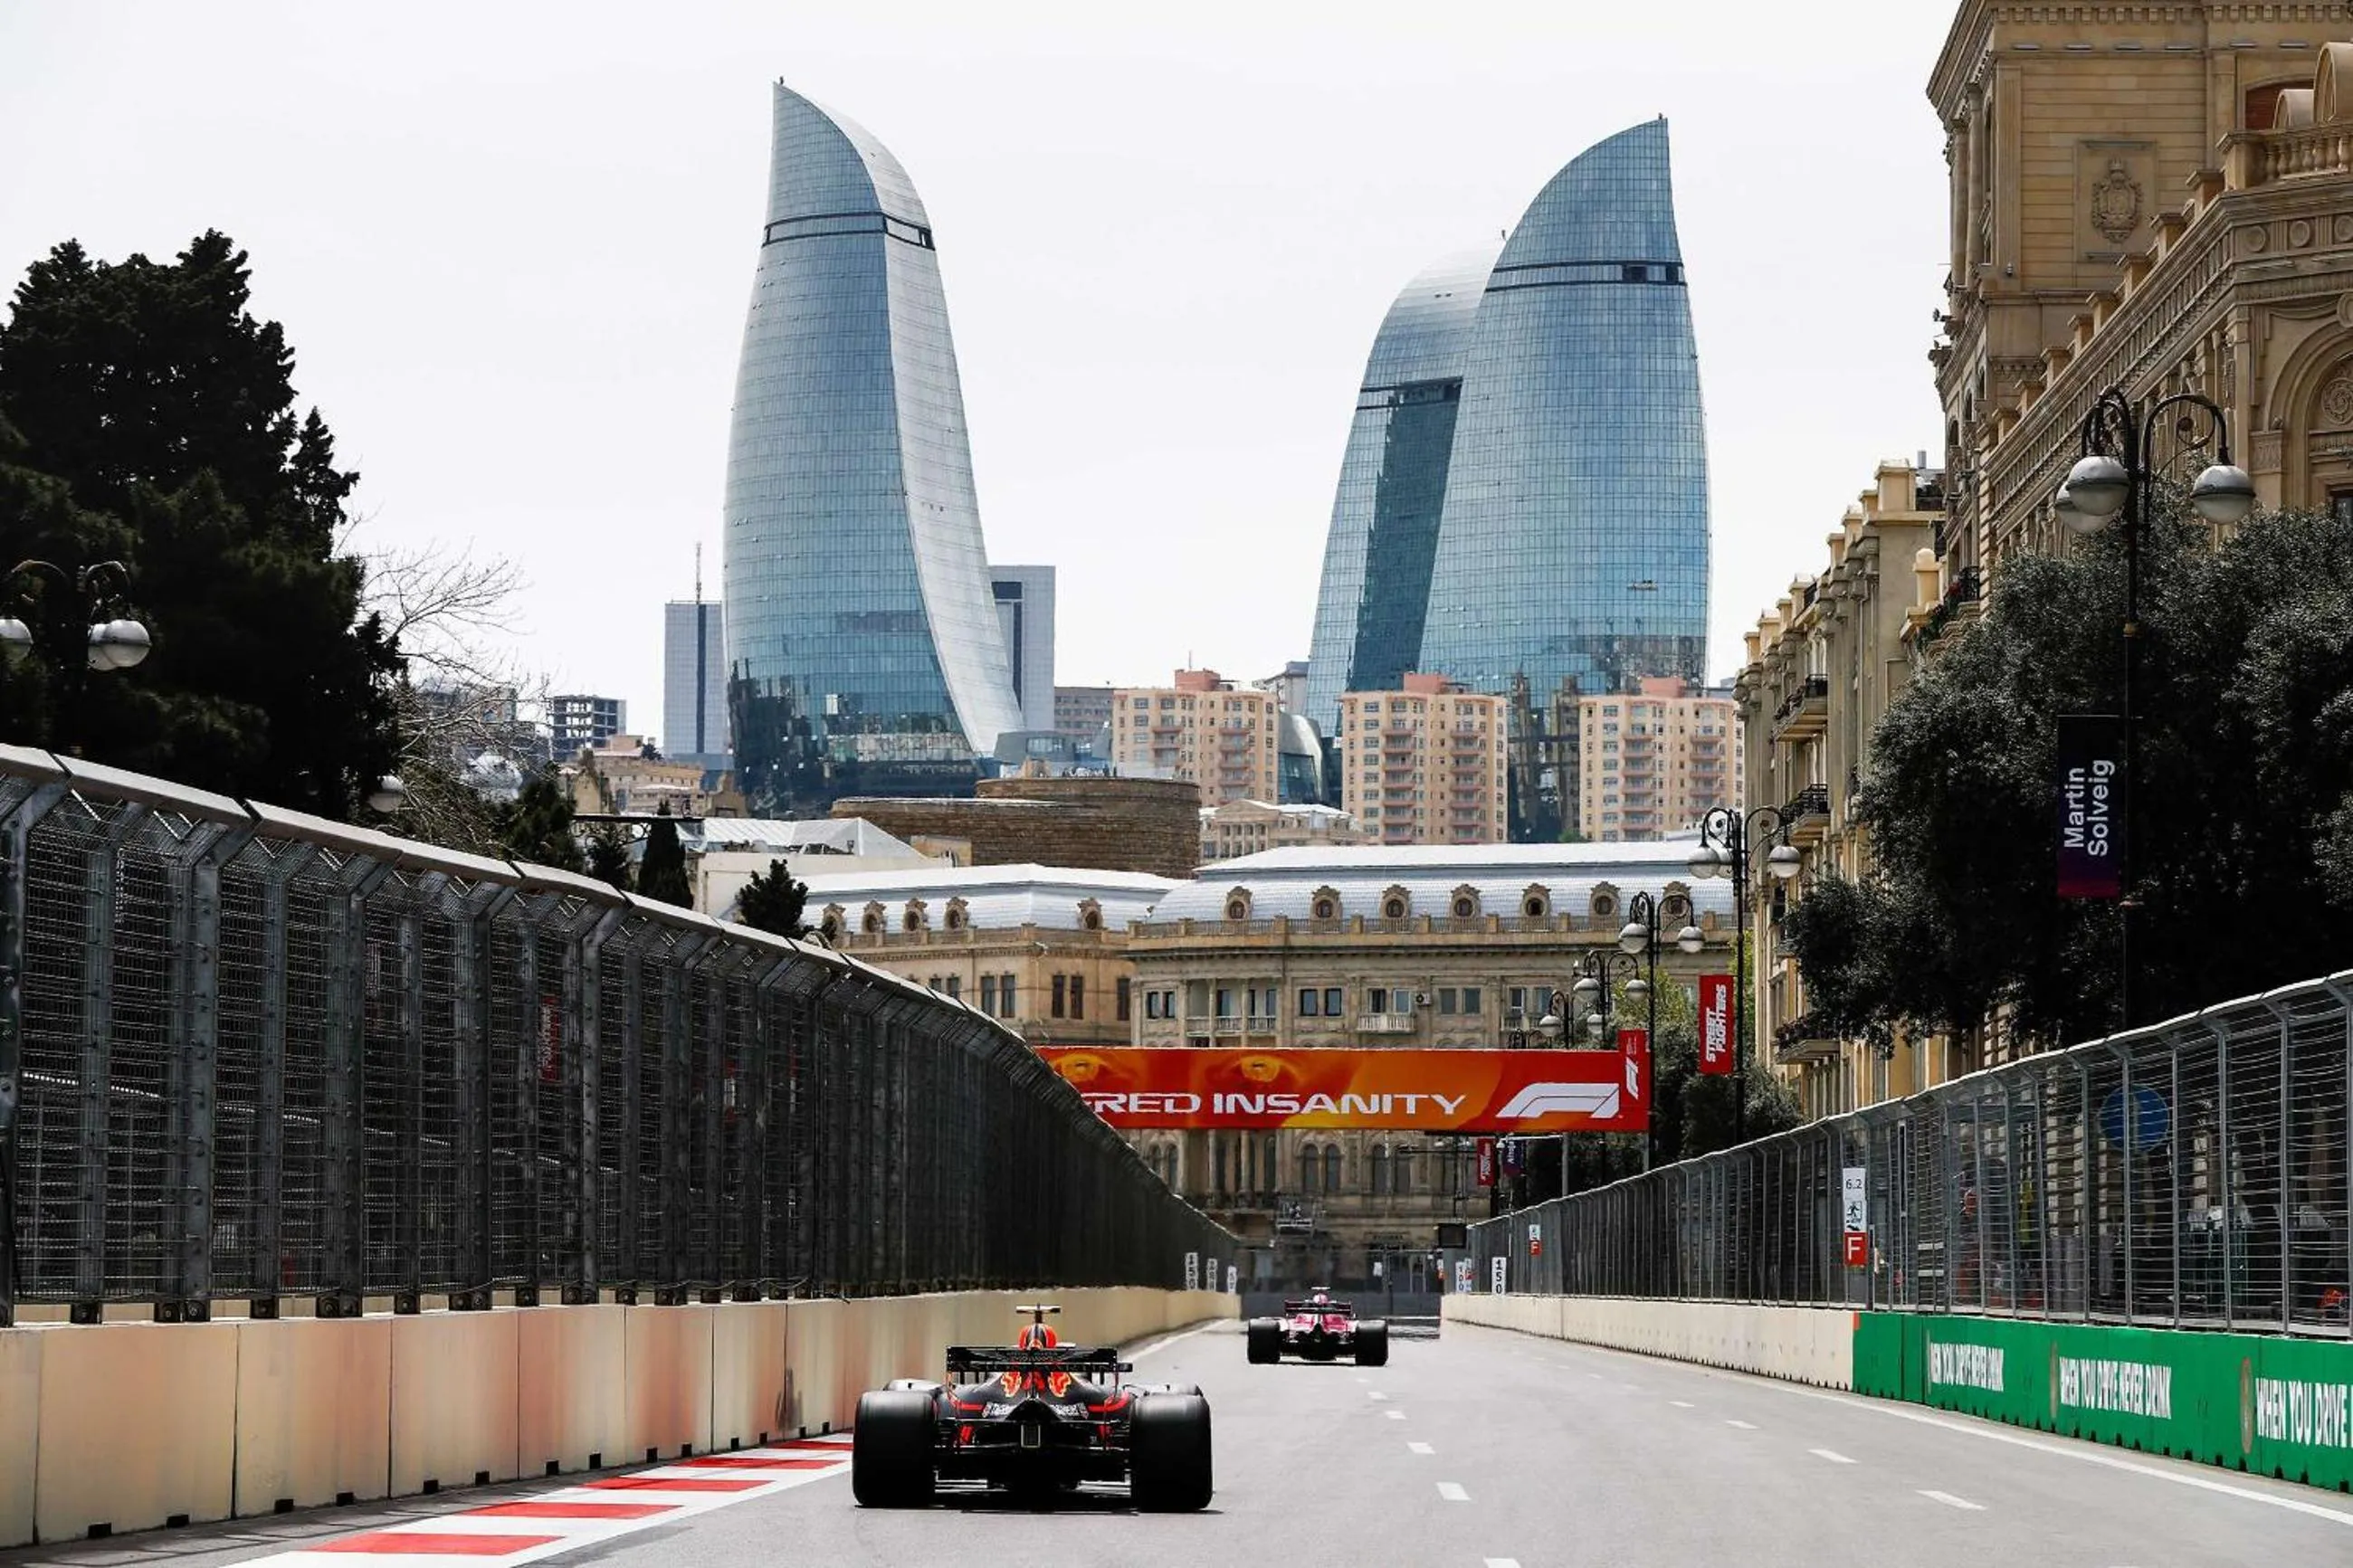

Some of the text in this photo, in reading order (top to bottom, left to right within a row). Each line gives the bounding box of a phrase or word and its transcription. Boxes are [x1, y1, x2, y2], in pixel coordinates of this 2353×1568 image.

[2063, 767, 2085, 848] Martin
[2086, 759, 2115, 857] Solveig
[1706, 1006, 1716, 1063] STREET
[1716, 984, 1727, 1053] FIGHTERS
[1213, 1092, 1467, 1115] INSANITY
[1847, 1236, 1863, 1261] F
[2059, 1356, 2172, 1420] WHEN YOU DRIVE NEVER DRINK
[2255, 1377, 2287, 1440] WHEN
[2288, 1379, 2312, 1446] YOU
[2314, 1382, 2348, 1449] DRIVE
